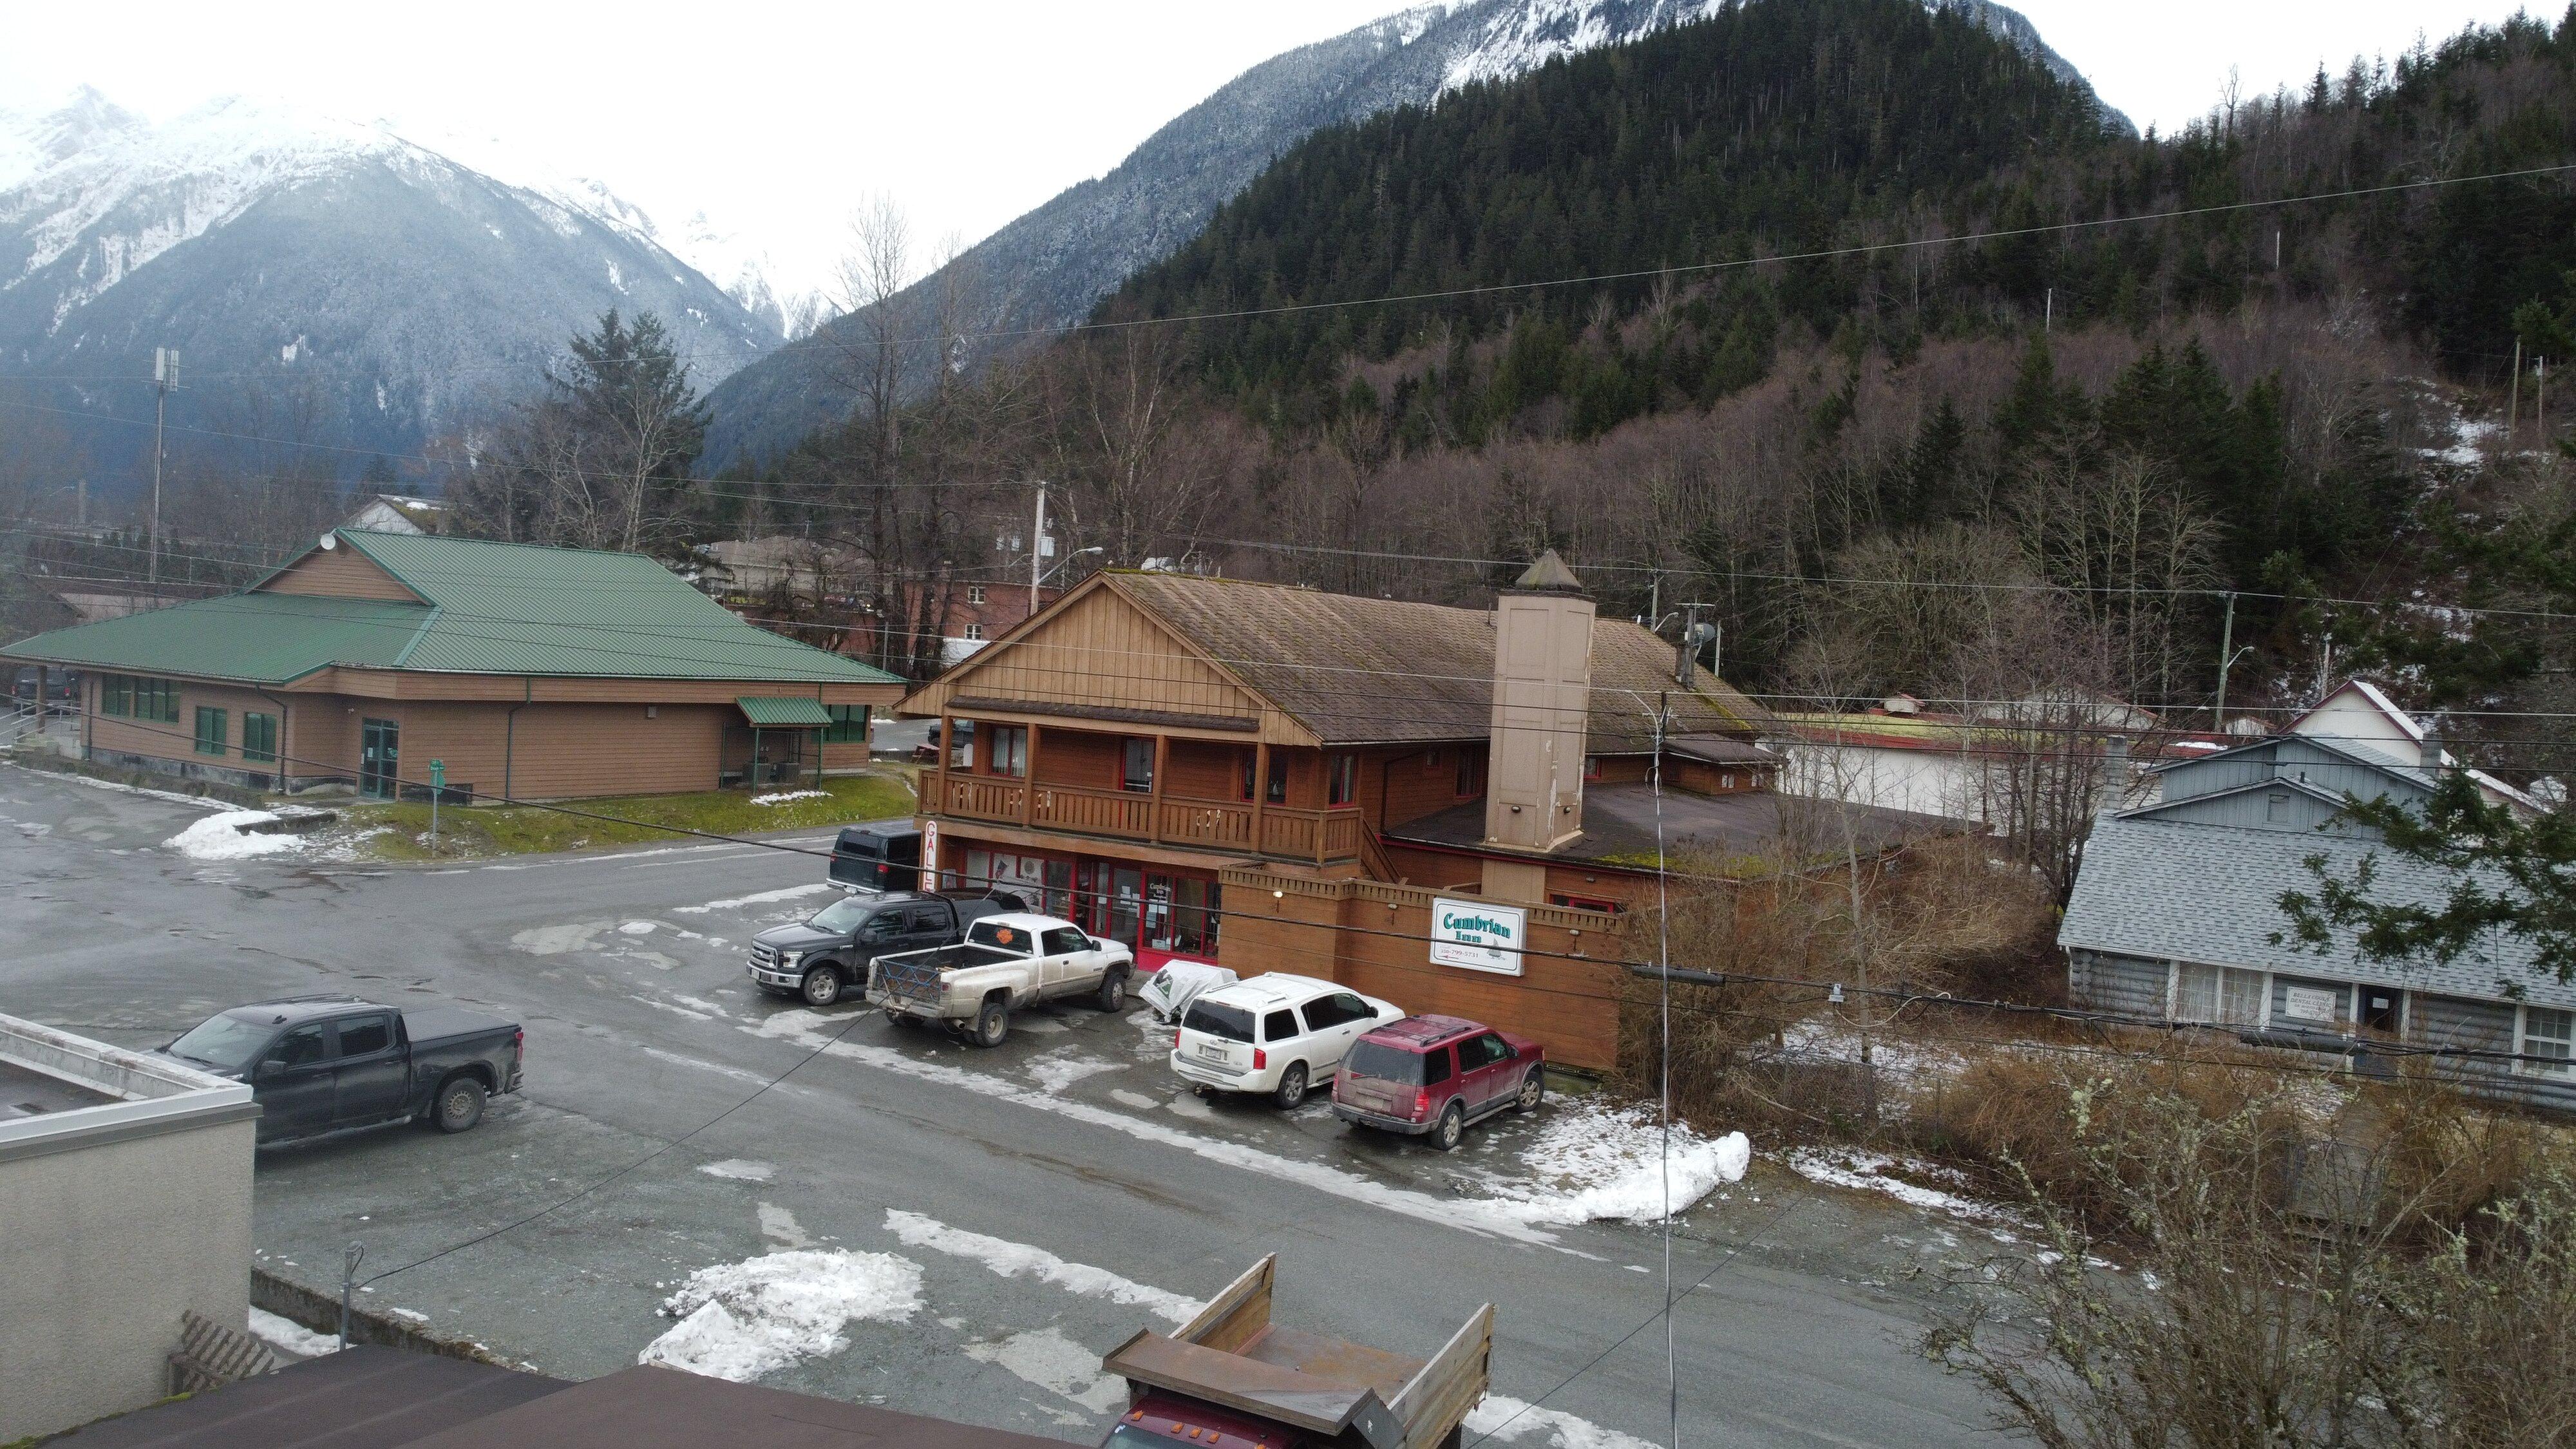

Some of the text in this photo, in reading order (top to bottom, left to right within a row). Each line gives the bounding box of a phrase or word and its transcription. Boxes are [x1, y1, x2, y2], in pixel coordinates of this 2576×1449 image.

[1443, 912, 1511, 940] Cumbrian
[1455, 931, 1482, 943] Inn
[1440, 949, 1479, 958] 250-799-5731
